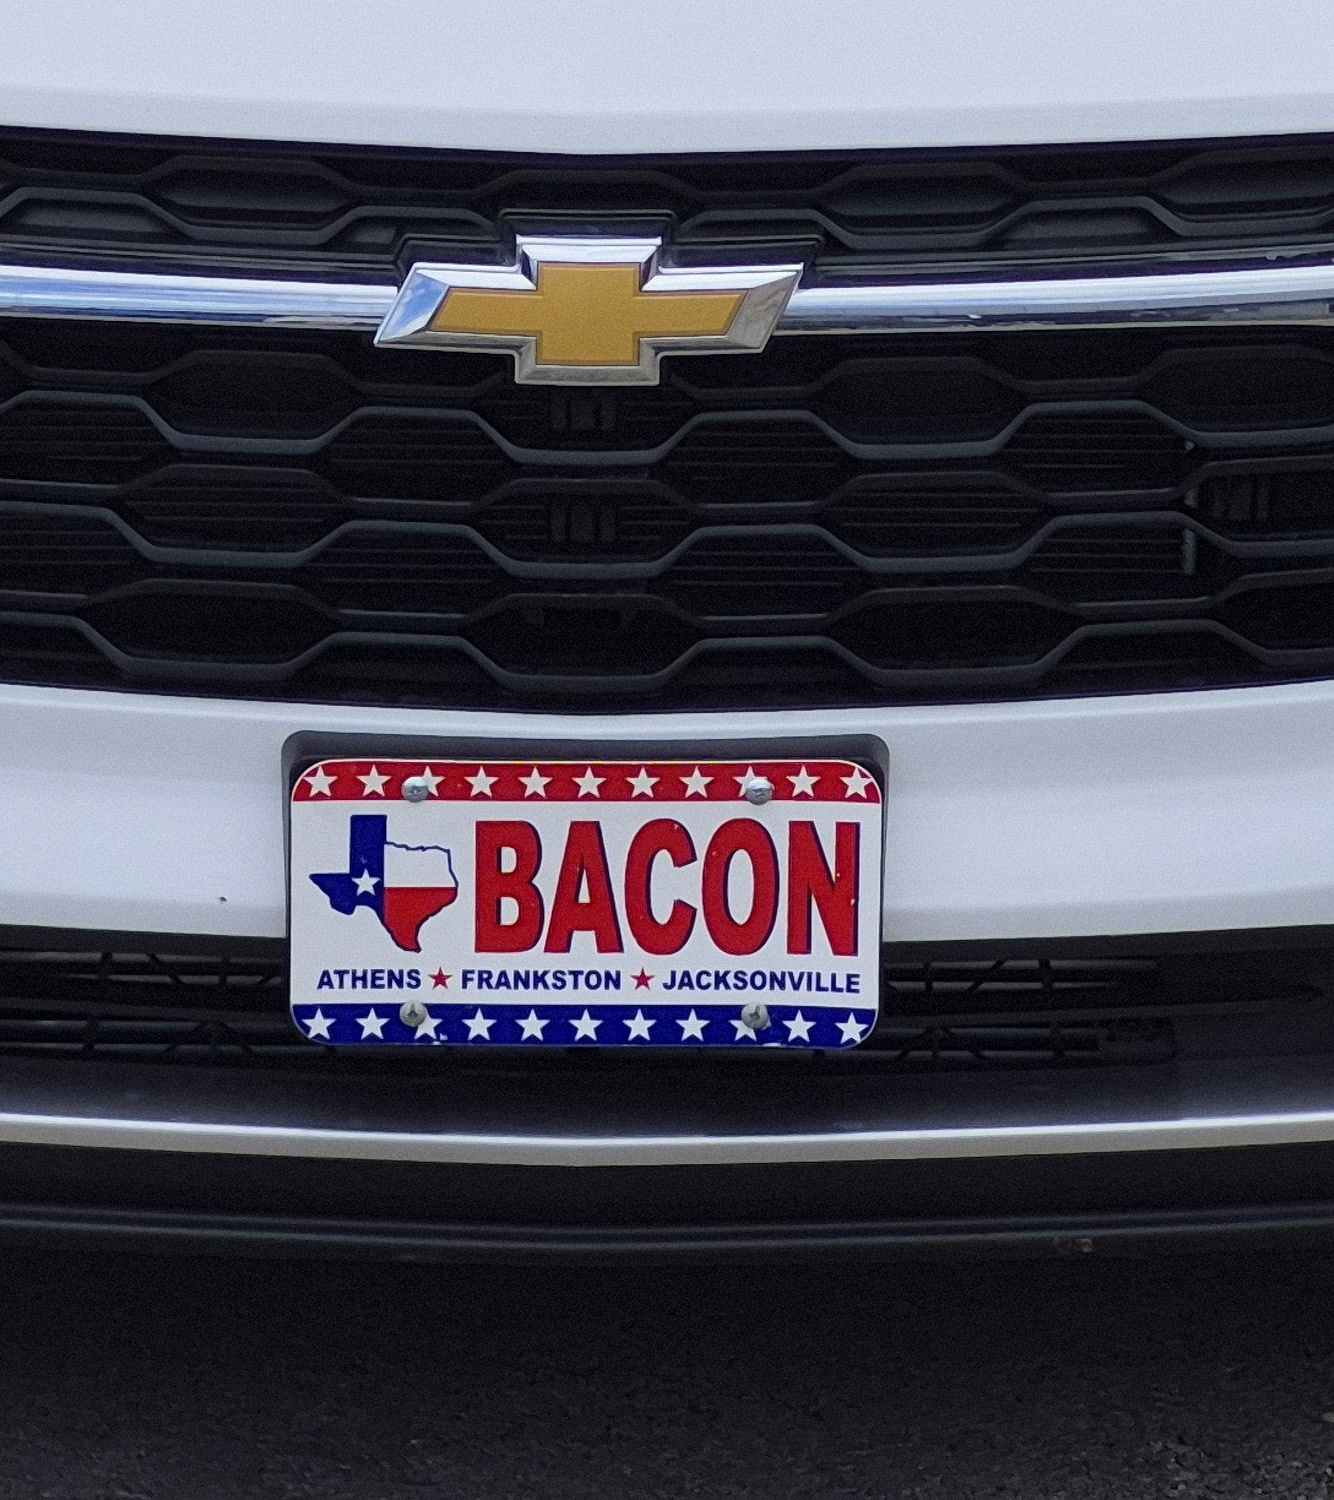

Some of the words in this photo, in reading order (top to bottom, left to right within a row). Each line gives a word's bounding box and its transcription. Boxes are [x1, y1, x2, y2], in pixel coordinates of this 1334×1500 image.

[474, 817, 861, 957] BACON
[316, 968, 422, 991] ATHENS
[460, 968, 622, 992] FRANKSTON
[662, 969, 861, 994] JACKSONVILLE
